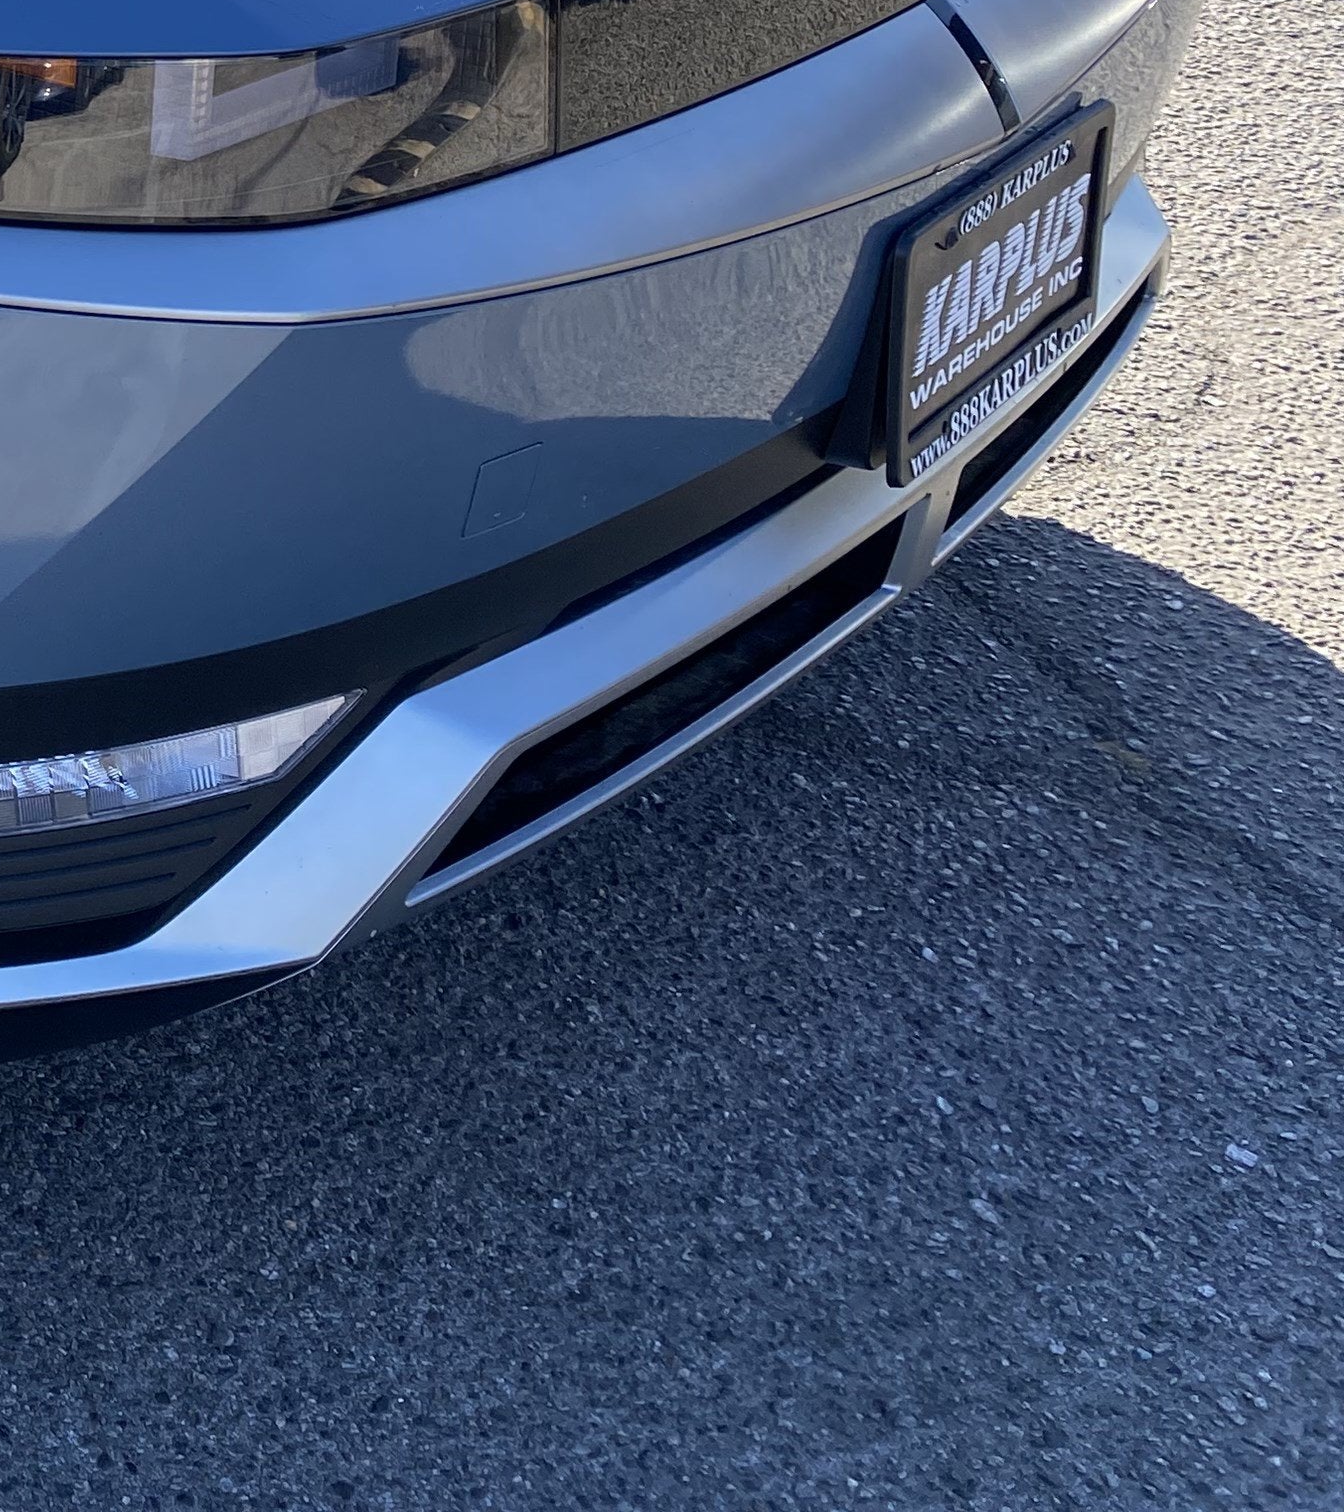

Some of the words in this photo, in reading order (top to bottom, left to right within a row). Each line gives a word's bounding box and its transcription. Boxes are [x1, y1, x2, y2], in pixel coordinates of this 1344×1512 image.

[960, 191, 997, 235] (888)
[1001, 140, 1071, 209] KARPLUS
[910, 287, 1043, 410] WAREHOUSE
[1049, 256, 1082, 296] INC
[912, 173, 1091, 377] KARPLUS
